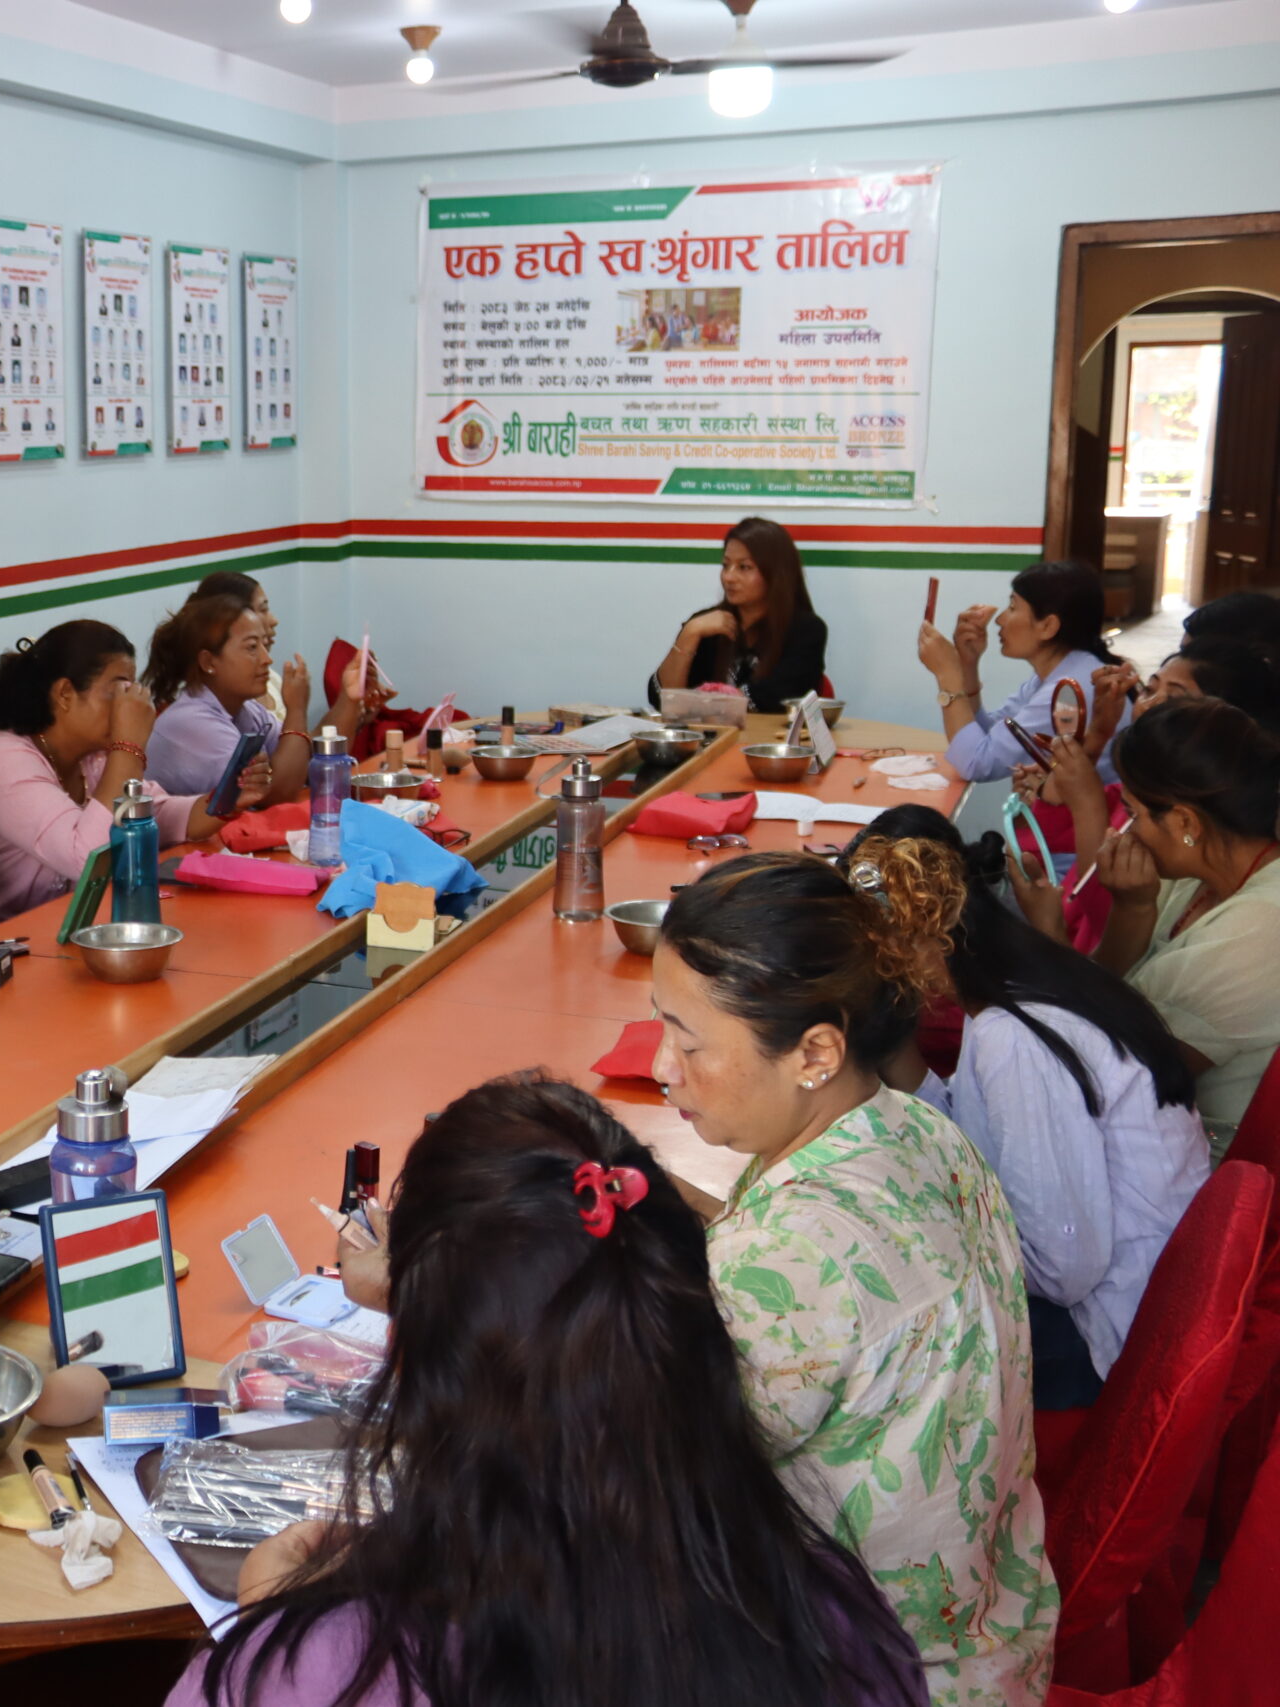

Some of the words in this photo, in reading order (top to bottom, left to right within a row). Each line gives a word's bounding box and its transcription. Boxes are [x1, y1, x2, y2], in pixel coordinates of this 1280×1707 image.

[444, 244, 503, 279] एक
[515, 231, 586, 280] हप्ते
[776, 220, 909, 270] तालिम
[794, 305, 868, 323] आयोजक
[779, 329, 816, 345] महिला
[823, 327, 882, 345] उपसमिति
[849, 415, 905, 427] ACCESS
[502, 411, 522, 456] श्री
[528, 411, 577, 457] बाराही
[581, 416, 614, 433] बचत
[622, 416, 649, 433] तथा
[657, 416, 690, 433] ऋण
[700, 412, 758, 434] सहकारी
[767, 413, 806, 433] संस्था
[578, 443, 604, 457] Shree
[607, 443, 637, 458] Barahi
[640, 443, 672, 460] Saving
[674, 444, 681, 457] &
[684, 443, 713, 458] Credit
[715, 444, 776, 460] Co-operative
[780, 445, 815, 462] Society
